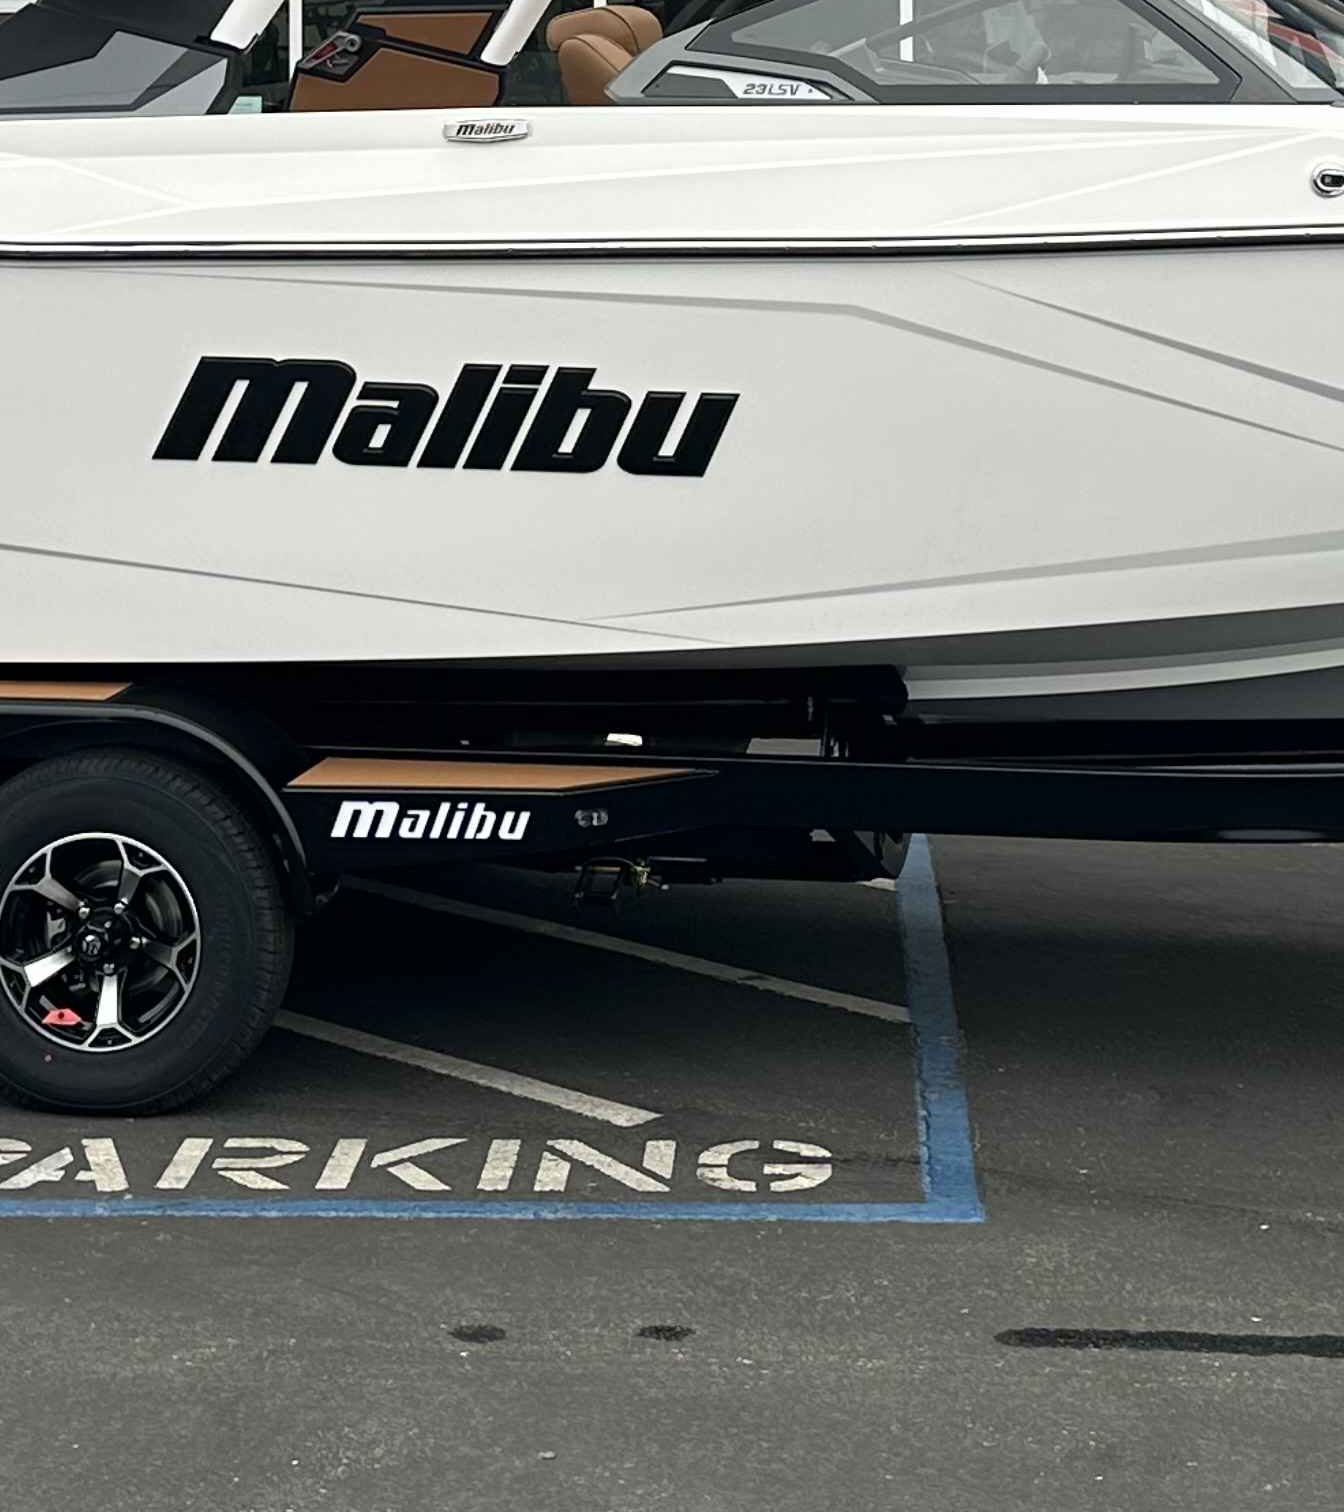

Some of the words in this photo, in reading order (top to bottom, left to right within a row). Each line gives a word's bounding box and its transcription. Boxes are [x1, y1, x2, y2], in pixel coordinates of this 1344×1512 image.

[456, 122, 516, 137] Malibu
[151, 355, 740, 478] Malibu
[329, 800, 531, 840] Malibu
